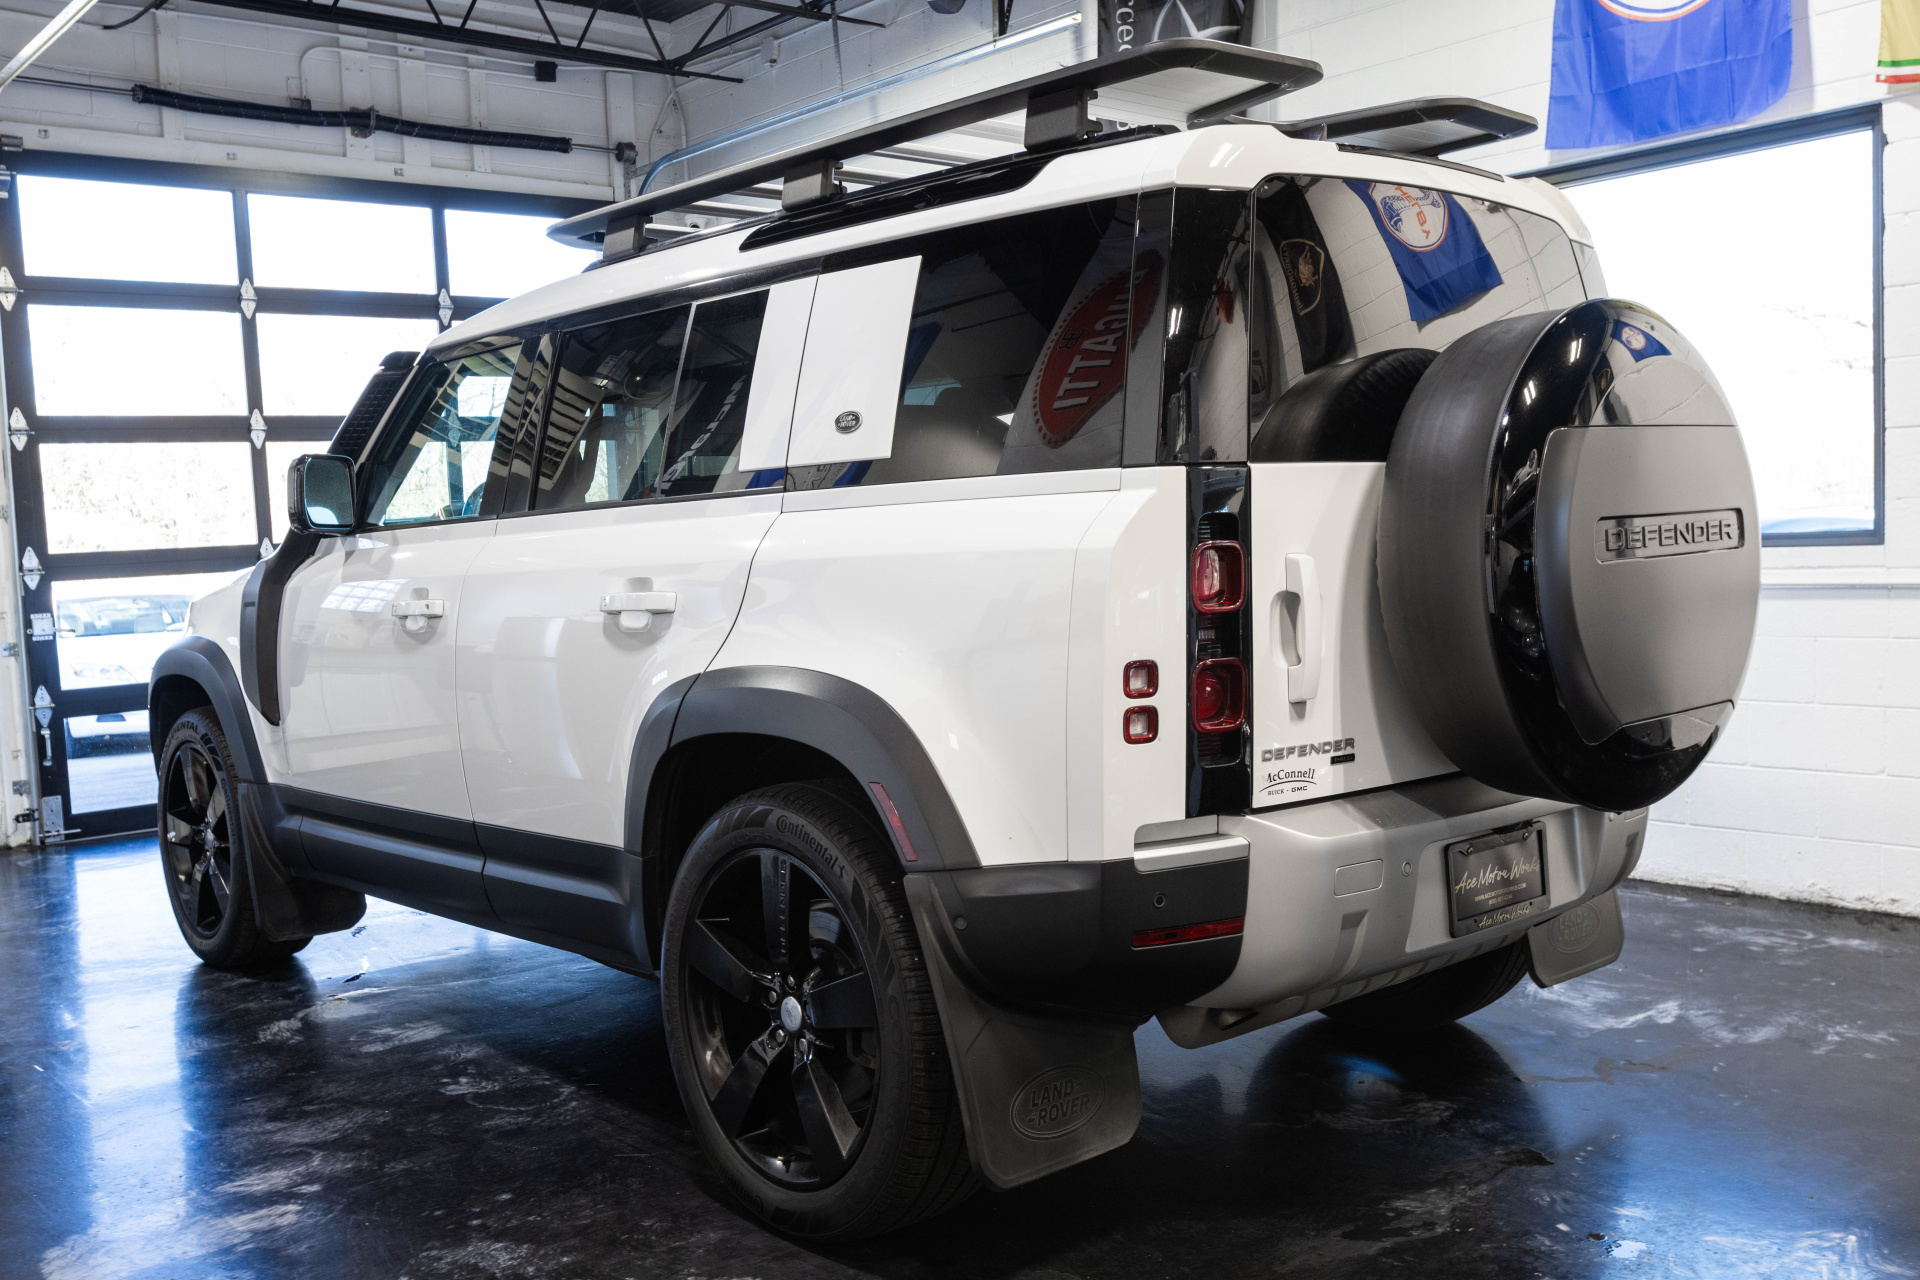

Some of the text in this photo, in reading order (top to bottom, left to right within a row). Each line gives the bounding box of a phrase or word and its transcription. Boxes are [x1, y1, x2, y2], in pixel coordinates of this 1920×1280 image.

[1604, 518, 1734, 552] DEFENDER
[1261, 738, 1355, 762] DEFENDER
[1267, 785, 1308, 796] BUICK GMC
[775, 814, 840, 870] Continental
[1454, 871, 1478, 895] Ace
[1478, 863, 1510, 888] Motor
[1478, 915, 1493, 929] Ace
[1030, 1078, 1074, 1108] LAND
[1037, 1093, 1091, 1127] ROVER
